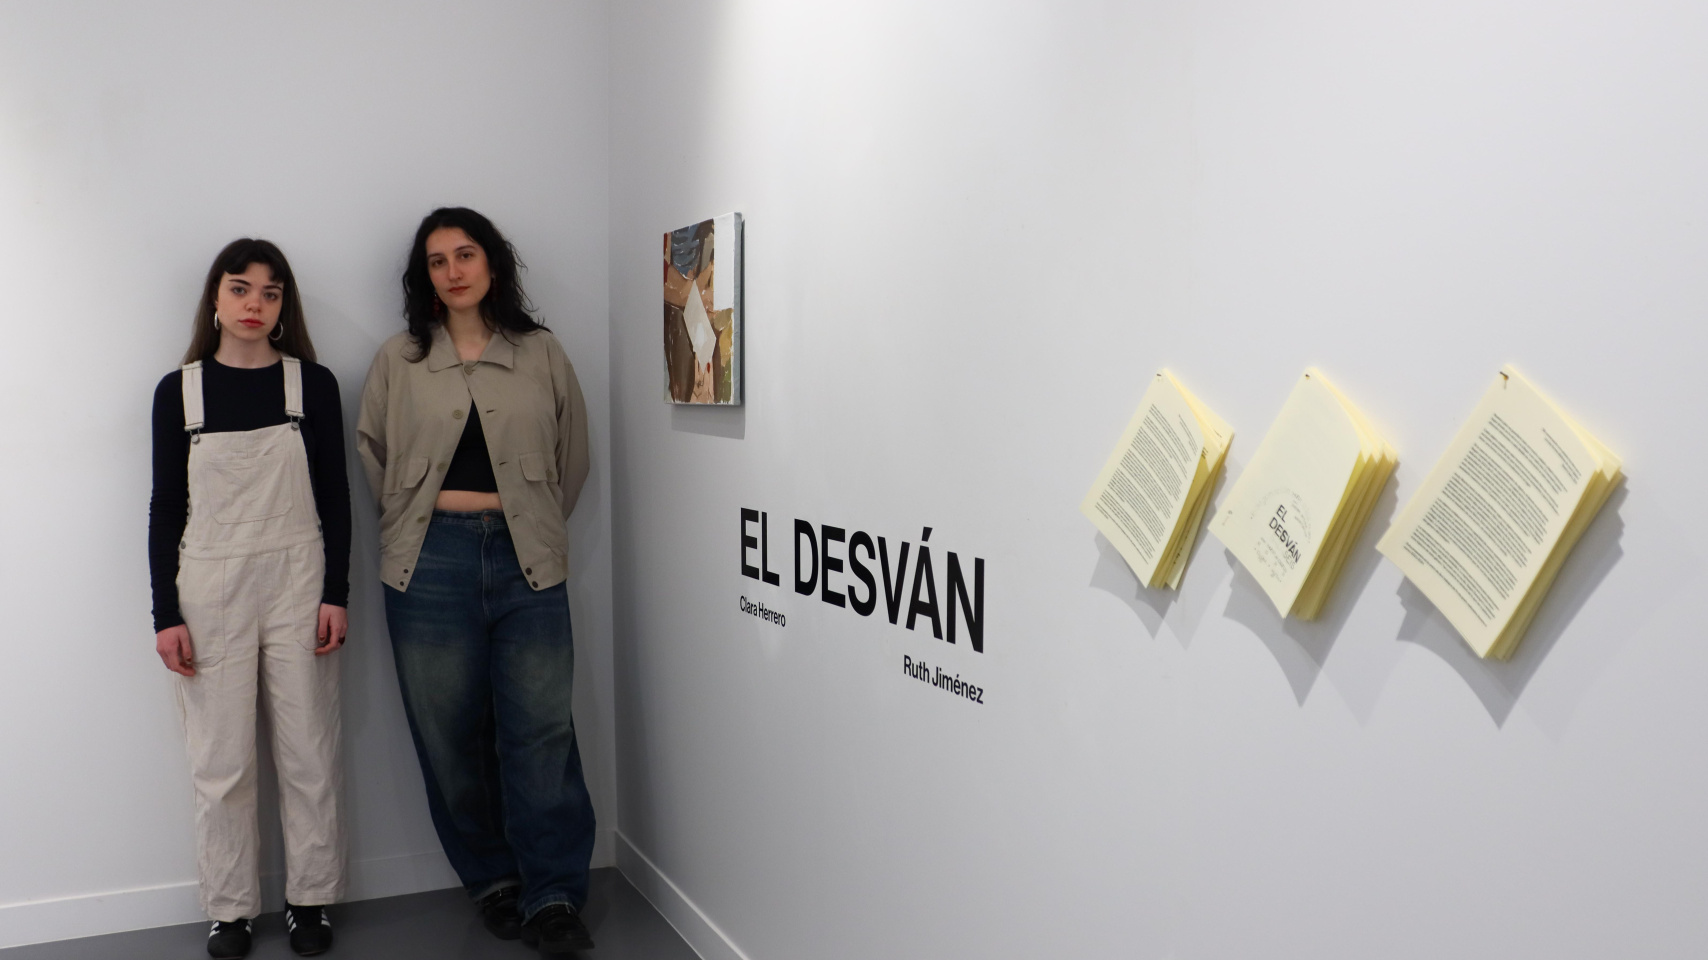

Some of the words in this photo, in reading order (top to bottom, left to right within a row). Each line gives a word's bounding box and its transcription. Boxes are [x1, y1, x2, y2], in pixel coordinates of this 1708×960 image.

[1275, 504, 1288, 523] EL
[1268, 516, 1301, 563] DESVÁN
[740, 507, 780, 587] EL
[794, 518, 985, 654] DESVÁN
[740, 595, 758, 615] Clara
[758, 602, 786, 627] Herrero
[903, 654, 930, 683] Ruth
[932, 666, 984, 705] Jiménez
